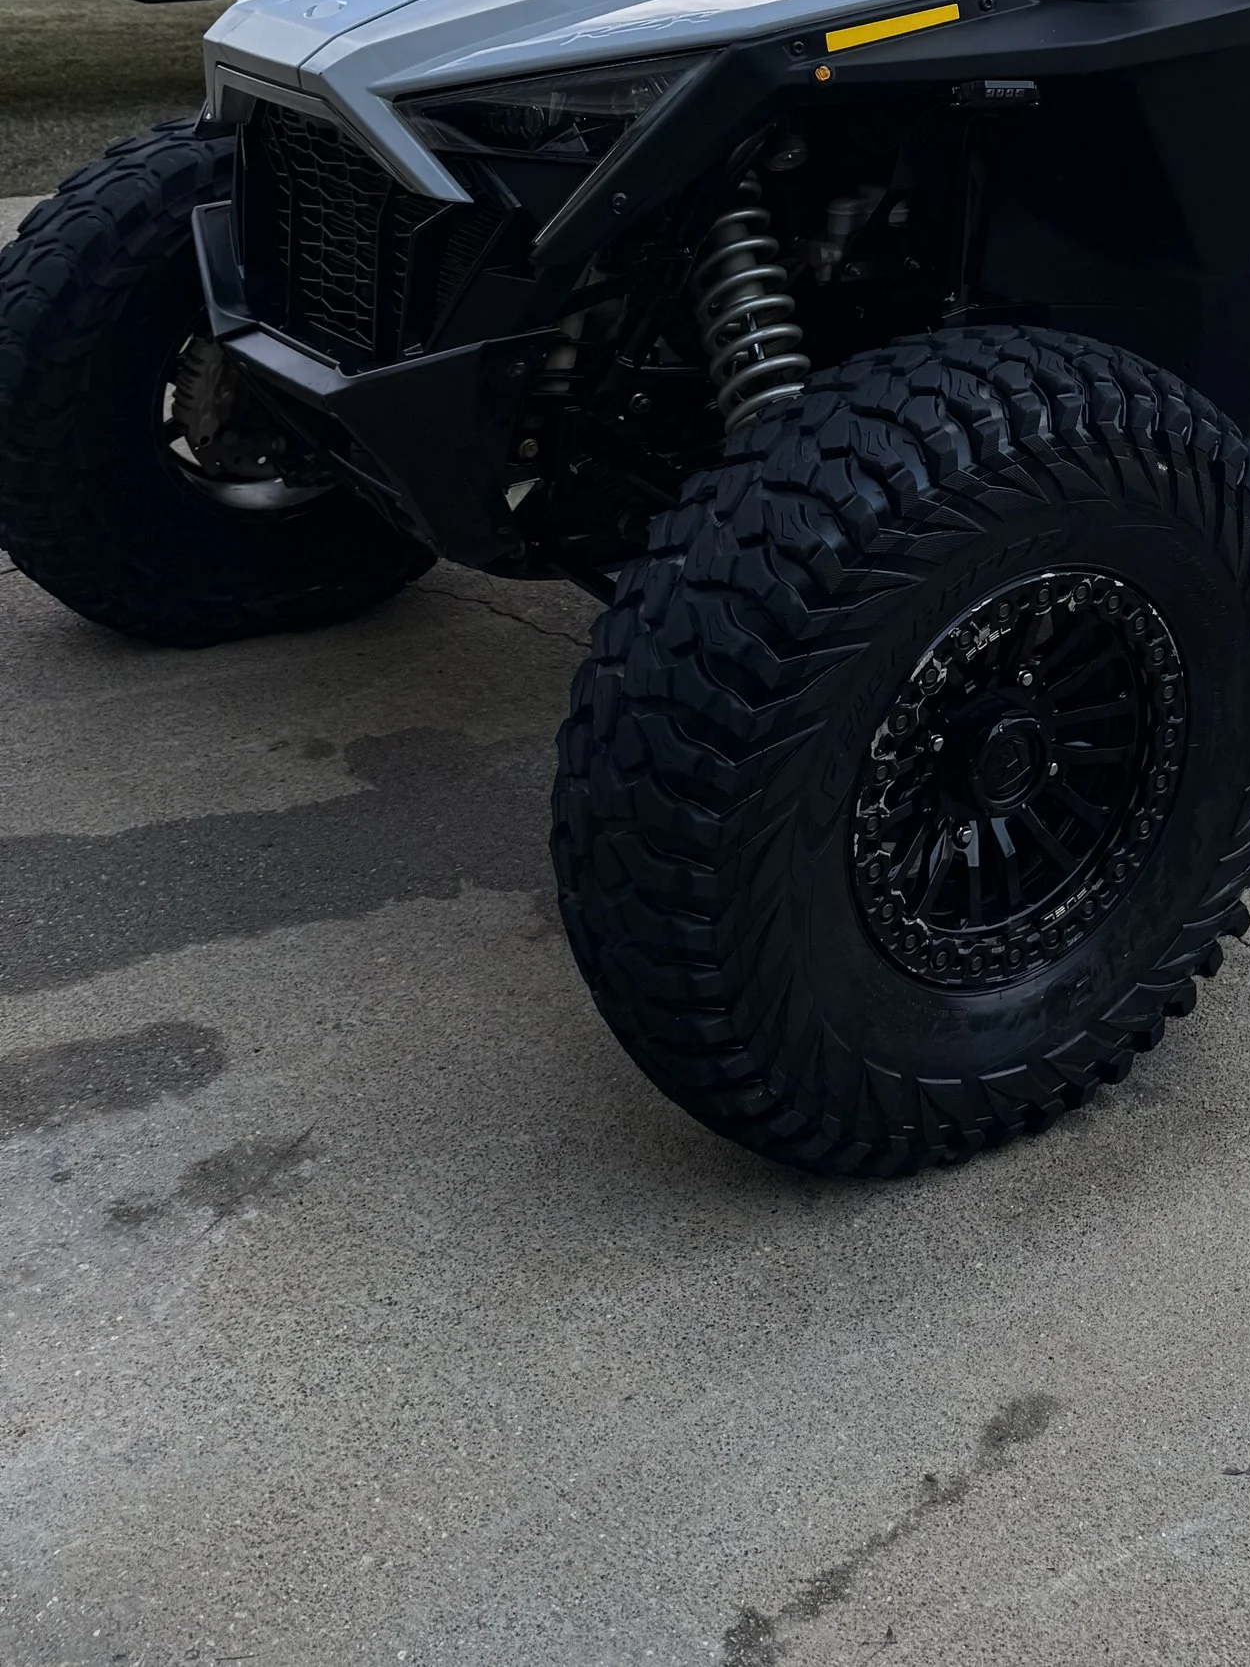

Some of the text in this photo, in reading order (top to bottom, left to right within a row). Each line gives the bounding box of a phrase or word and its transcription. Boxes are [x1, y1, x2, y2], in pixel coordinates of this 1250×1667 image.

[559, 7, 722, 46] RZR
[965, 627, 1012, 662] FUEL
[1043, 887, 1087, 921] FUEL
